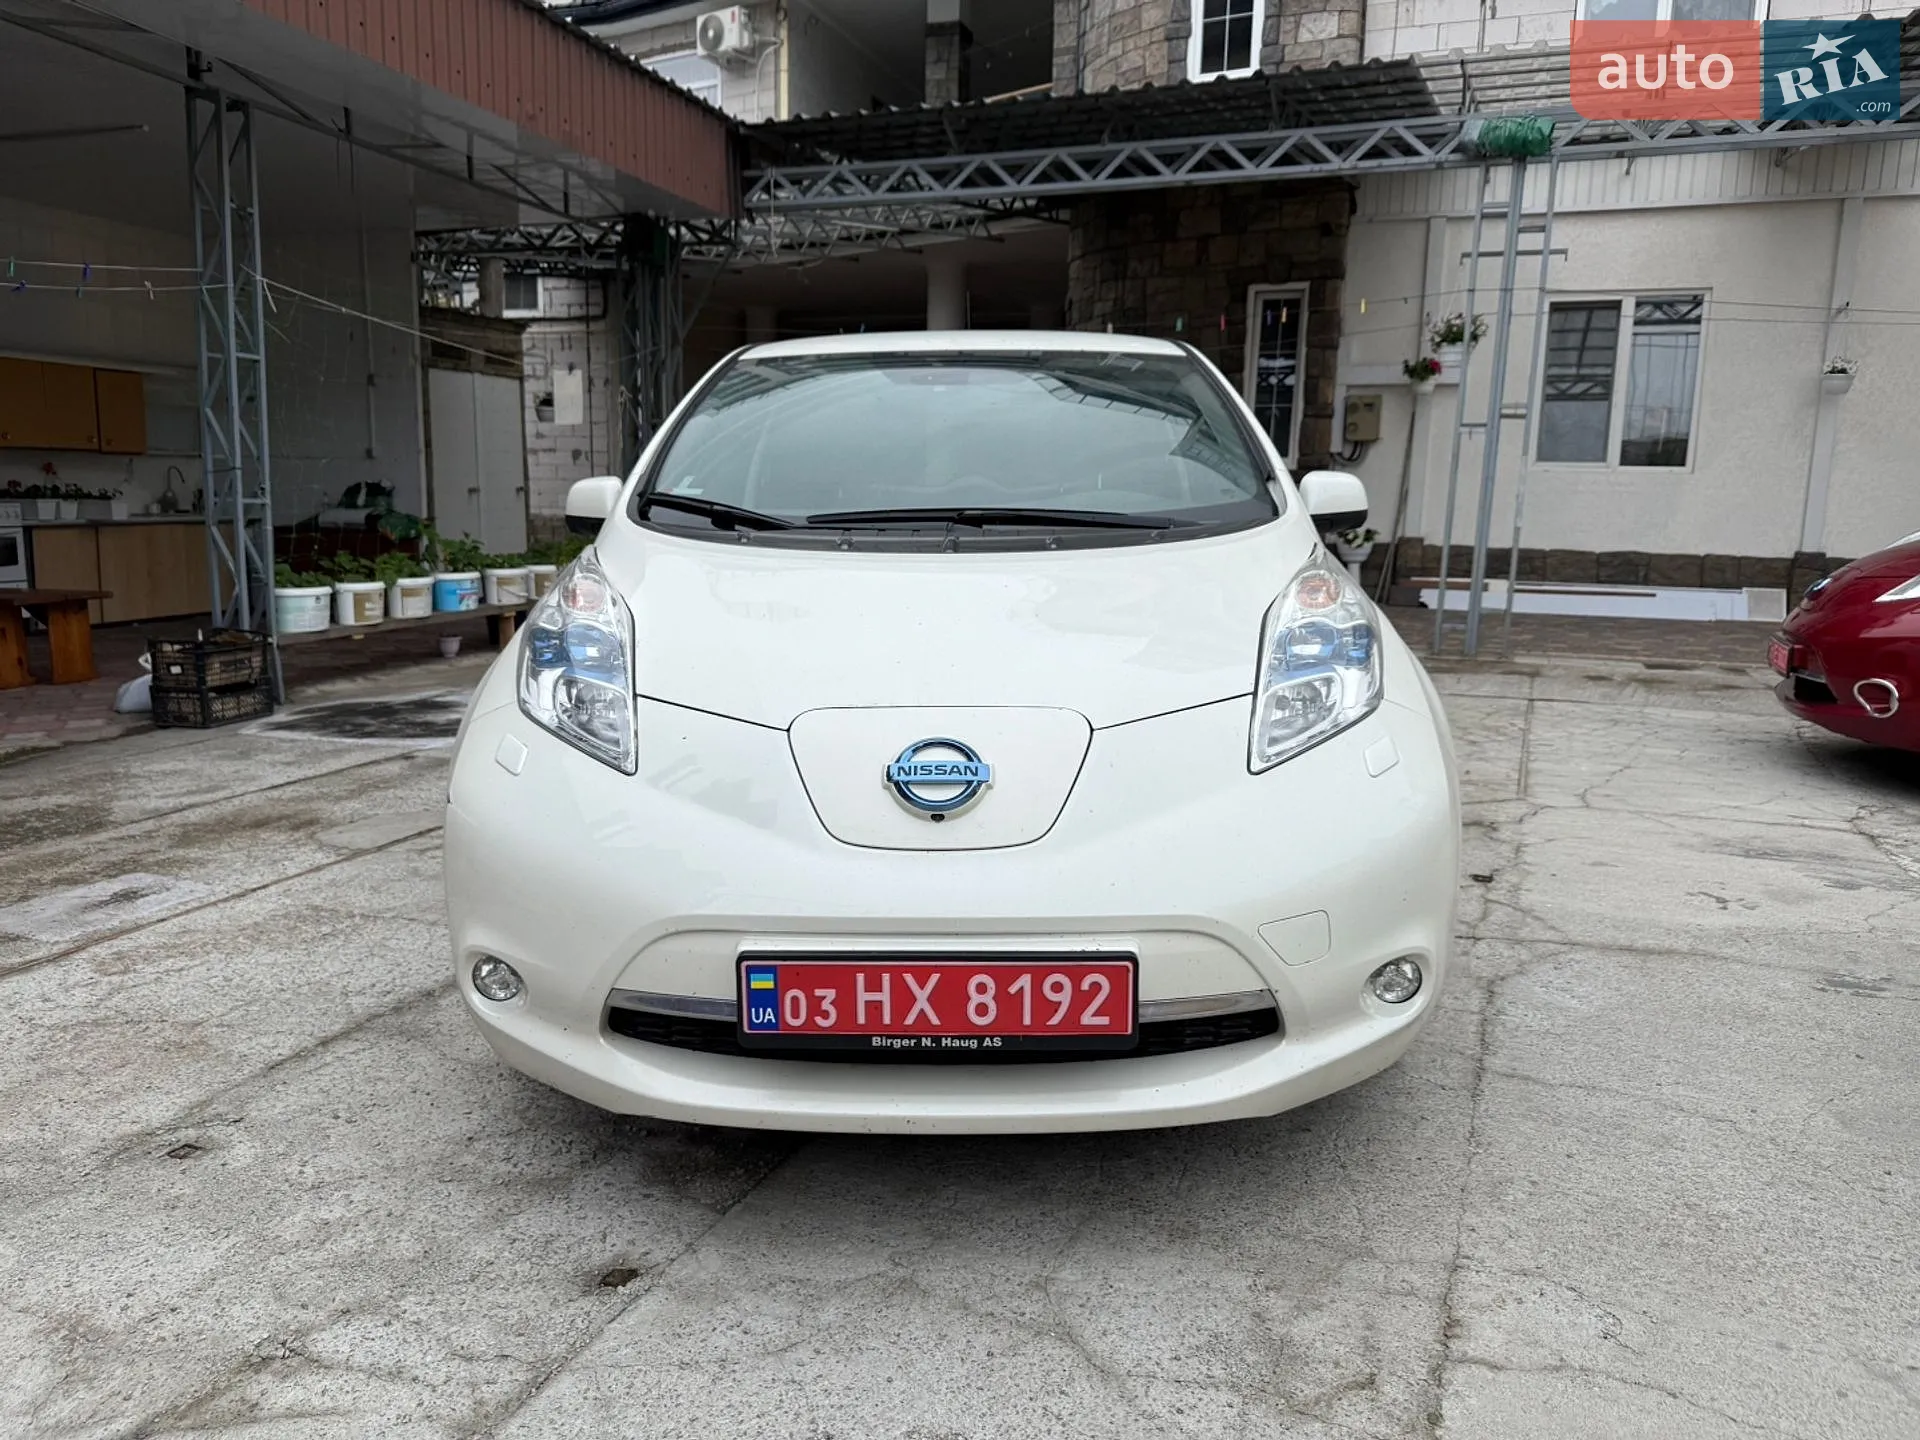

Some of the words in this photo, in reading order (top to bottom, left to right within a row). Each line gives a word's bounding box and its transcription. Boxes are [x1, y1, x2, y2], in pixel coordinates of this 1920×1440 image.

[897, 764, 979, 777] NISSAN
[783, 988, 838, 1028] 03
[855, 973, 941, 1026] HX
[966, 973, 1111, 1027] 8192
[751, 1007, 776, 1024] UA
[871, 1036, 917, 1049] Birger
[921, 1037, 936, 1047] N.
[941, 1037, 978, 1049] Haug
[983, 1037, 1002, 1047] AS
